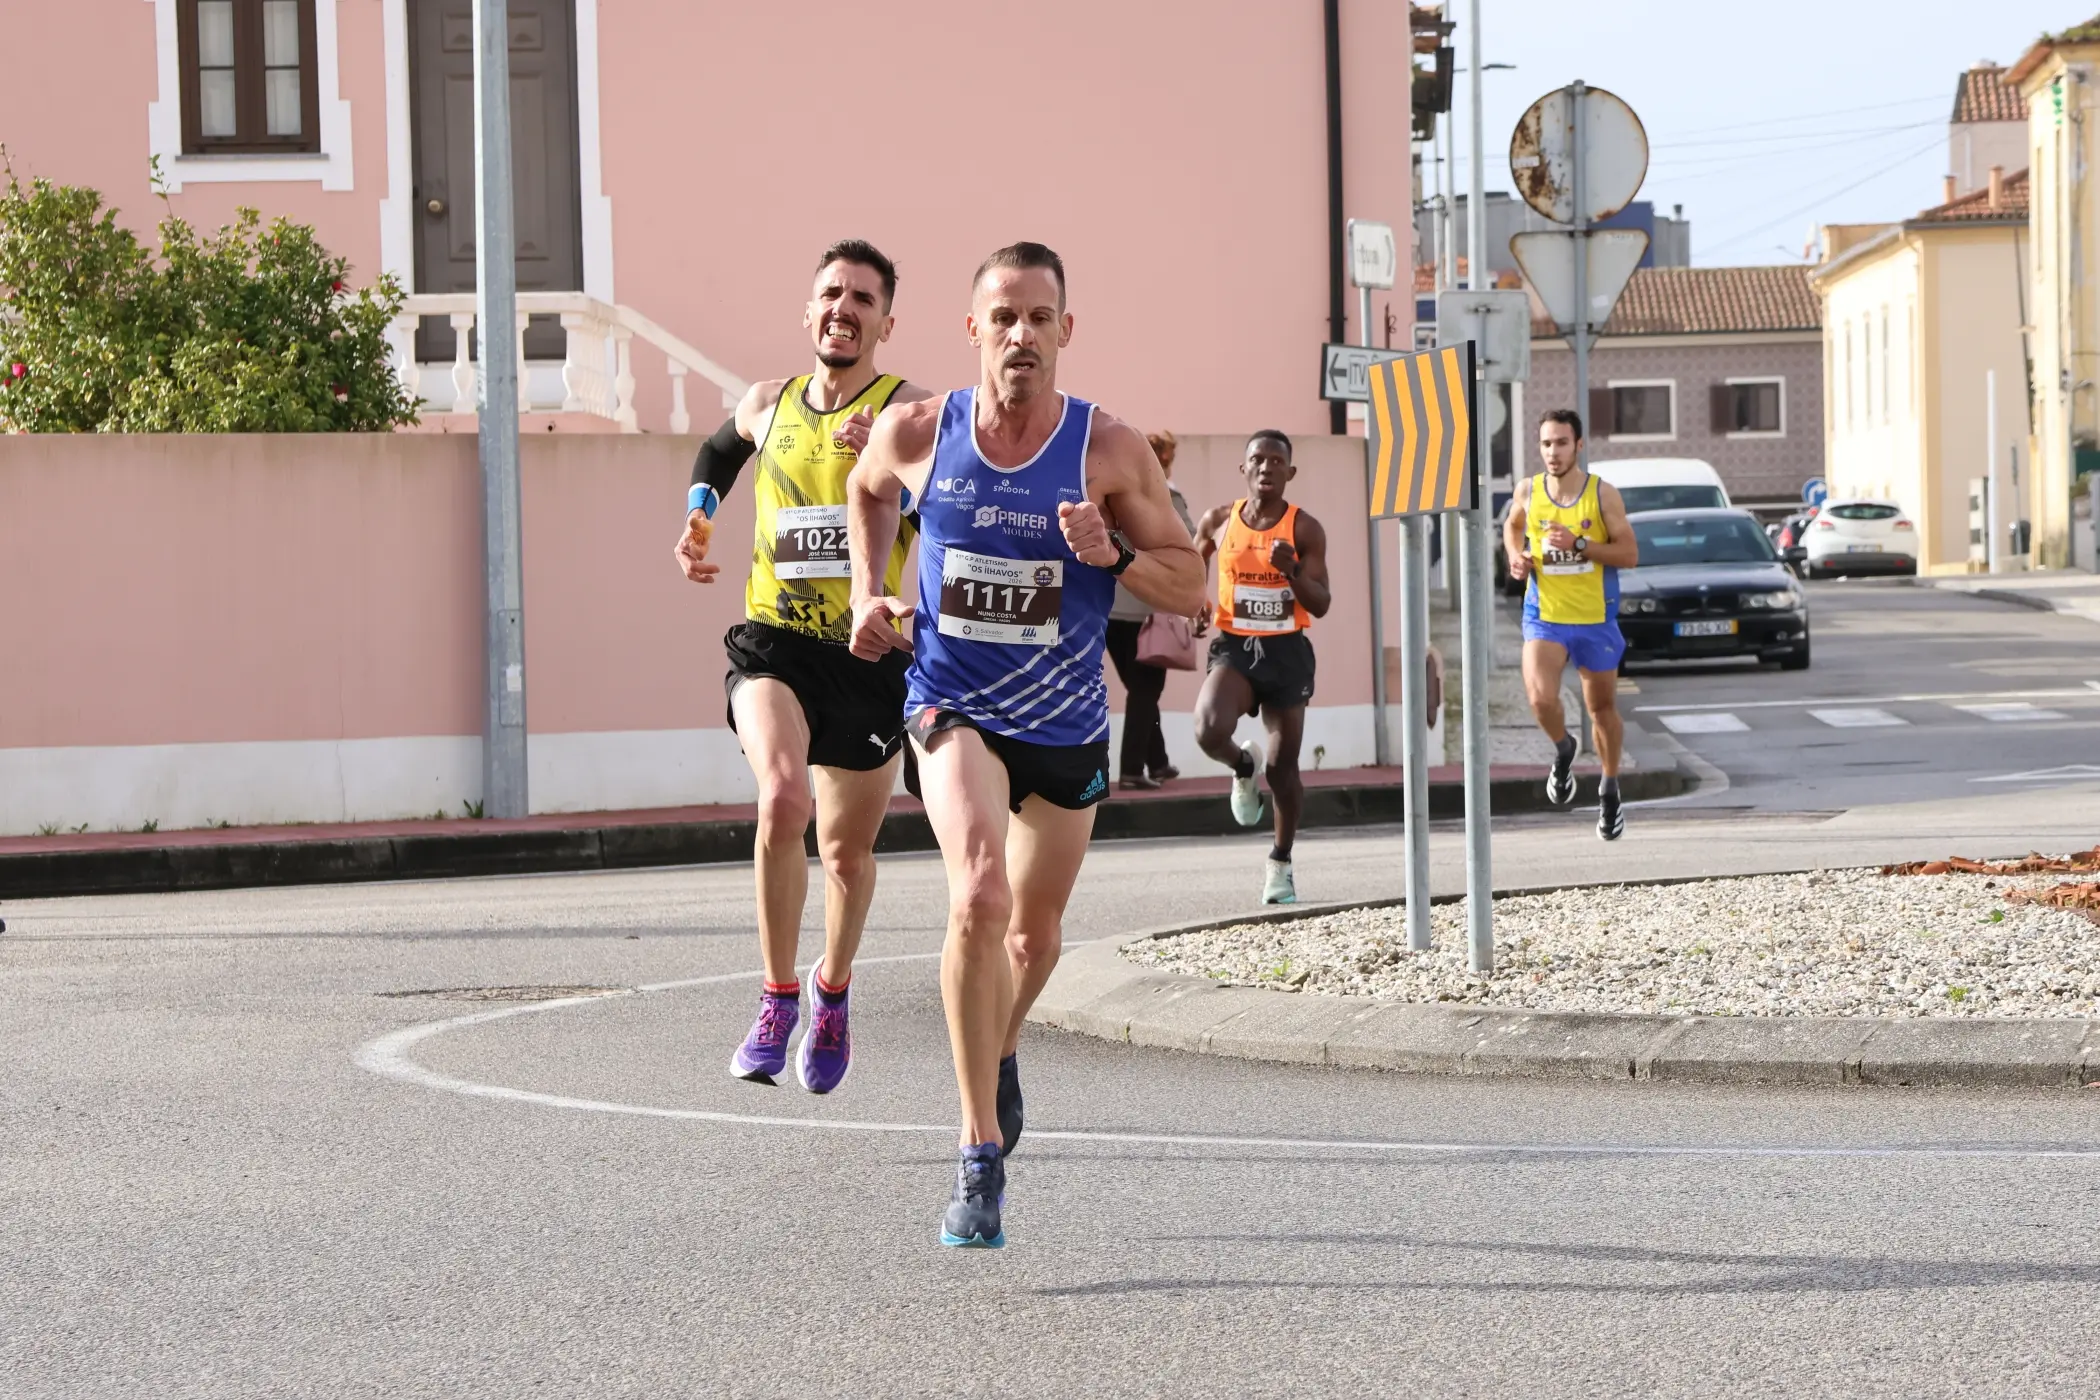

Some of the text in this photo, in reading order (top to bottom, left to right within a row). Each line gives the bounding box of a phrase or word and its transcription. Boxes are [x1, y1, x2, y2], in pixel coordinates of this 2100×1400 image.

[952, 478, 976, 494] CA
[993, 485, 1030, 496] SPIDORA
[955, 502, 975, 511] Vagos
[998, 510, 1048, 530] PRIFER
[793, 527, 849, 551] 1022
[1001, 526, 1042, 539] MOLDES
[974, 557, 1008, 567] ATLETISMO
[1008, 577, 1023, 585] 2026
[962, 582, 1037, 613] 1117
[977, 610, 1017, 620] NUNO COSTA
[1245, 600, 1283, 616] 1088
[1079, 780, 1106, 800] adidas
